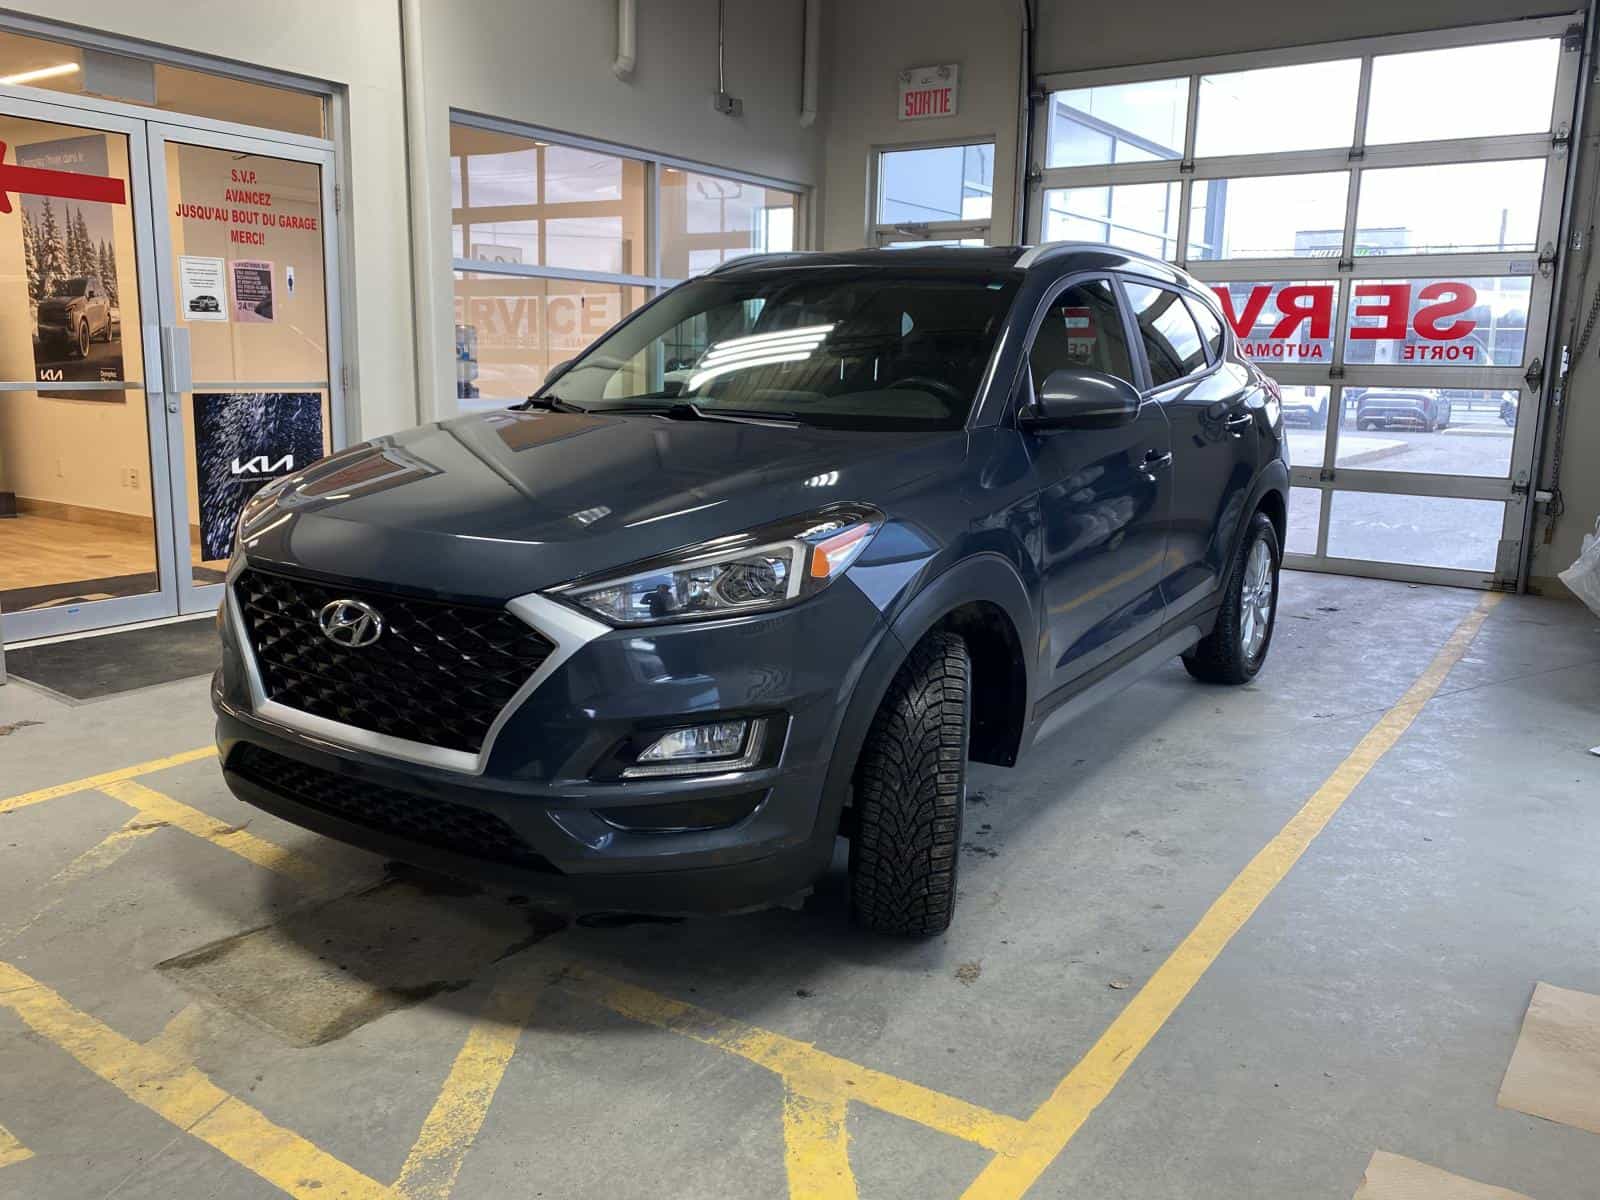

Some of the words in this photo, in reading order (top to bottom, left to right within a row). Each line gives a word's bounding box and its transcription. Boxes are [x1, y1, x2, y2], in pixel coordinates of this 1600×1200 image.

[905, 88, 952, 117] SORTIE
[231, 169, 257, 184] S.V.P.
[225, 189, 272, 207] AVANCEZ
[175, 203, 229, 222] JUSQU'AU
[232, 209, 259, 225] BOUT
[262, 213, 276, 227] DU
[278, 215, 317, 231] GARAGE
[230, 230, 265, 246] MERCI!
[40, 369, 64, 381] KIA
[231, 454, 294, 474] KIA
